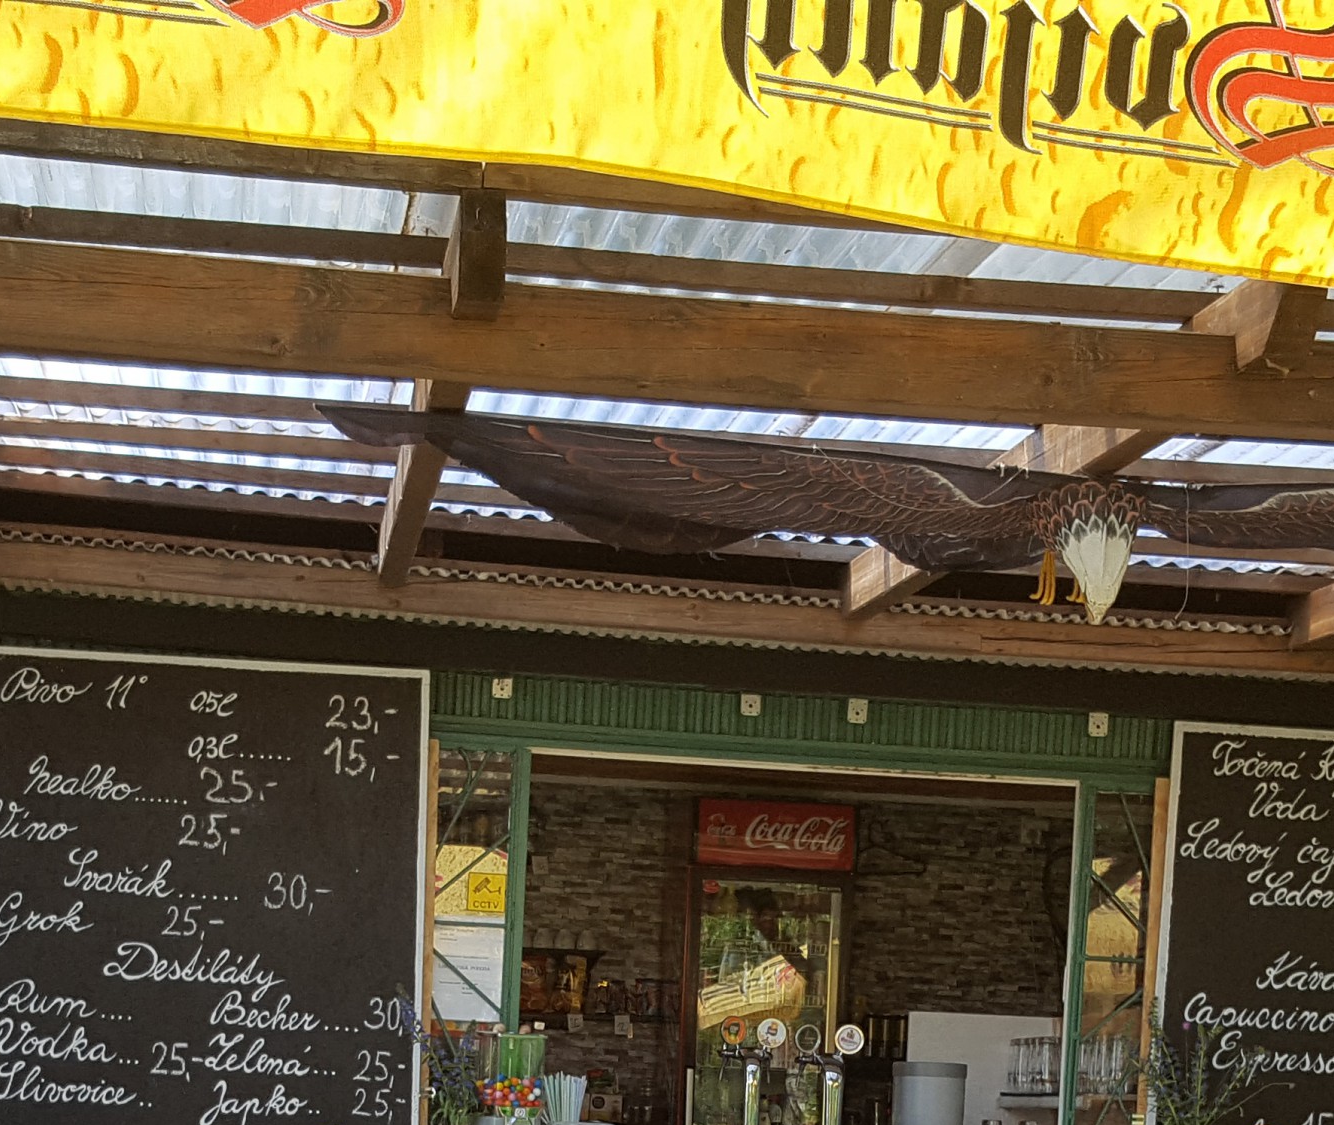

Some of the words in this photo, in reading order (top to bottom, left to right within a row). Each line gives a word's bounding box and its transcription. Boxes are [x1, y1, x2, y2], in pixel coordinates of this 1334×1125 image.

[0, 667, 93, 703] Pivo
[1211, 740, 1304, 780] Točená
[1248, 782, 1331, 822] Voda
[745, 813, 850, 855] Coca-Cola
[1180, 819, 1285, 883] Ledový
[472, 900, 500, 910] CCTV
[102, 941, 285, 996] Destiláty
